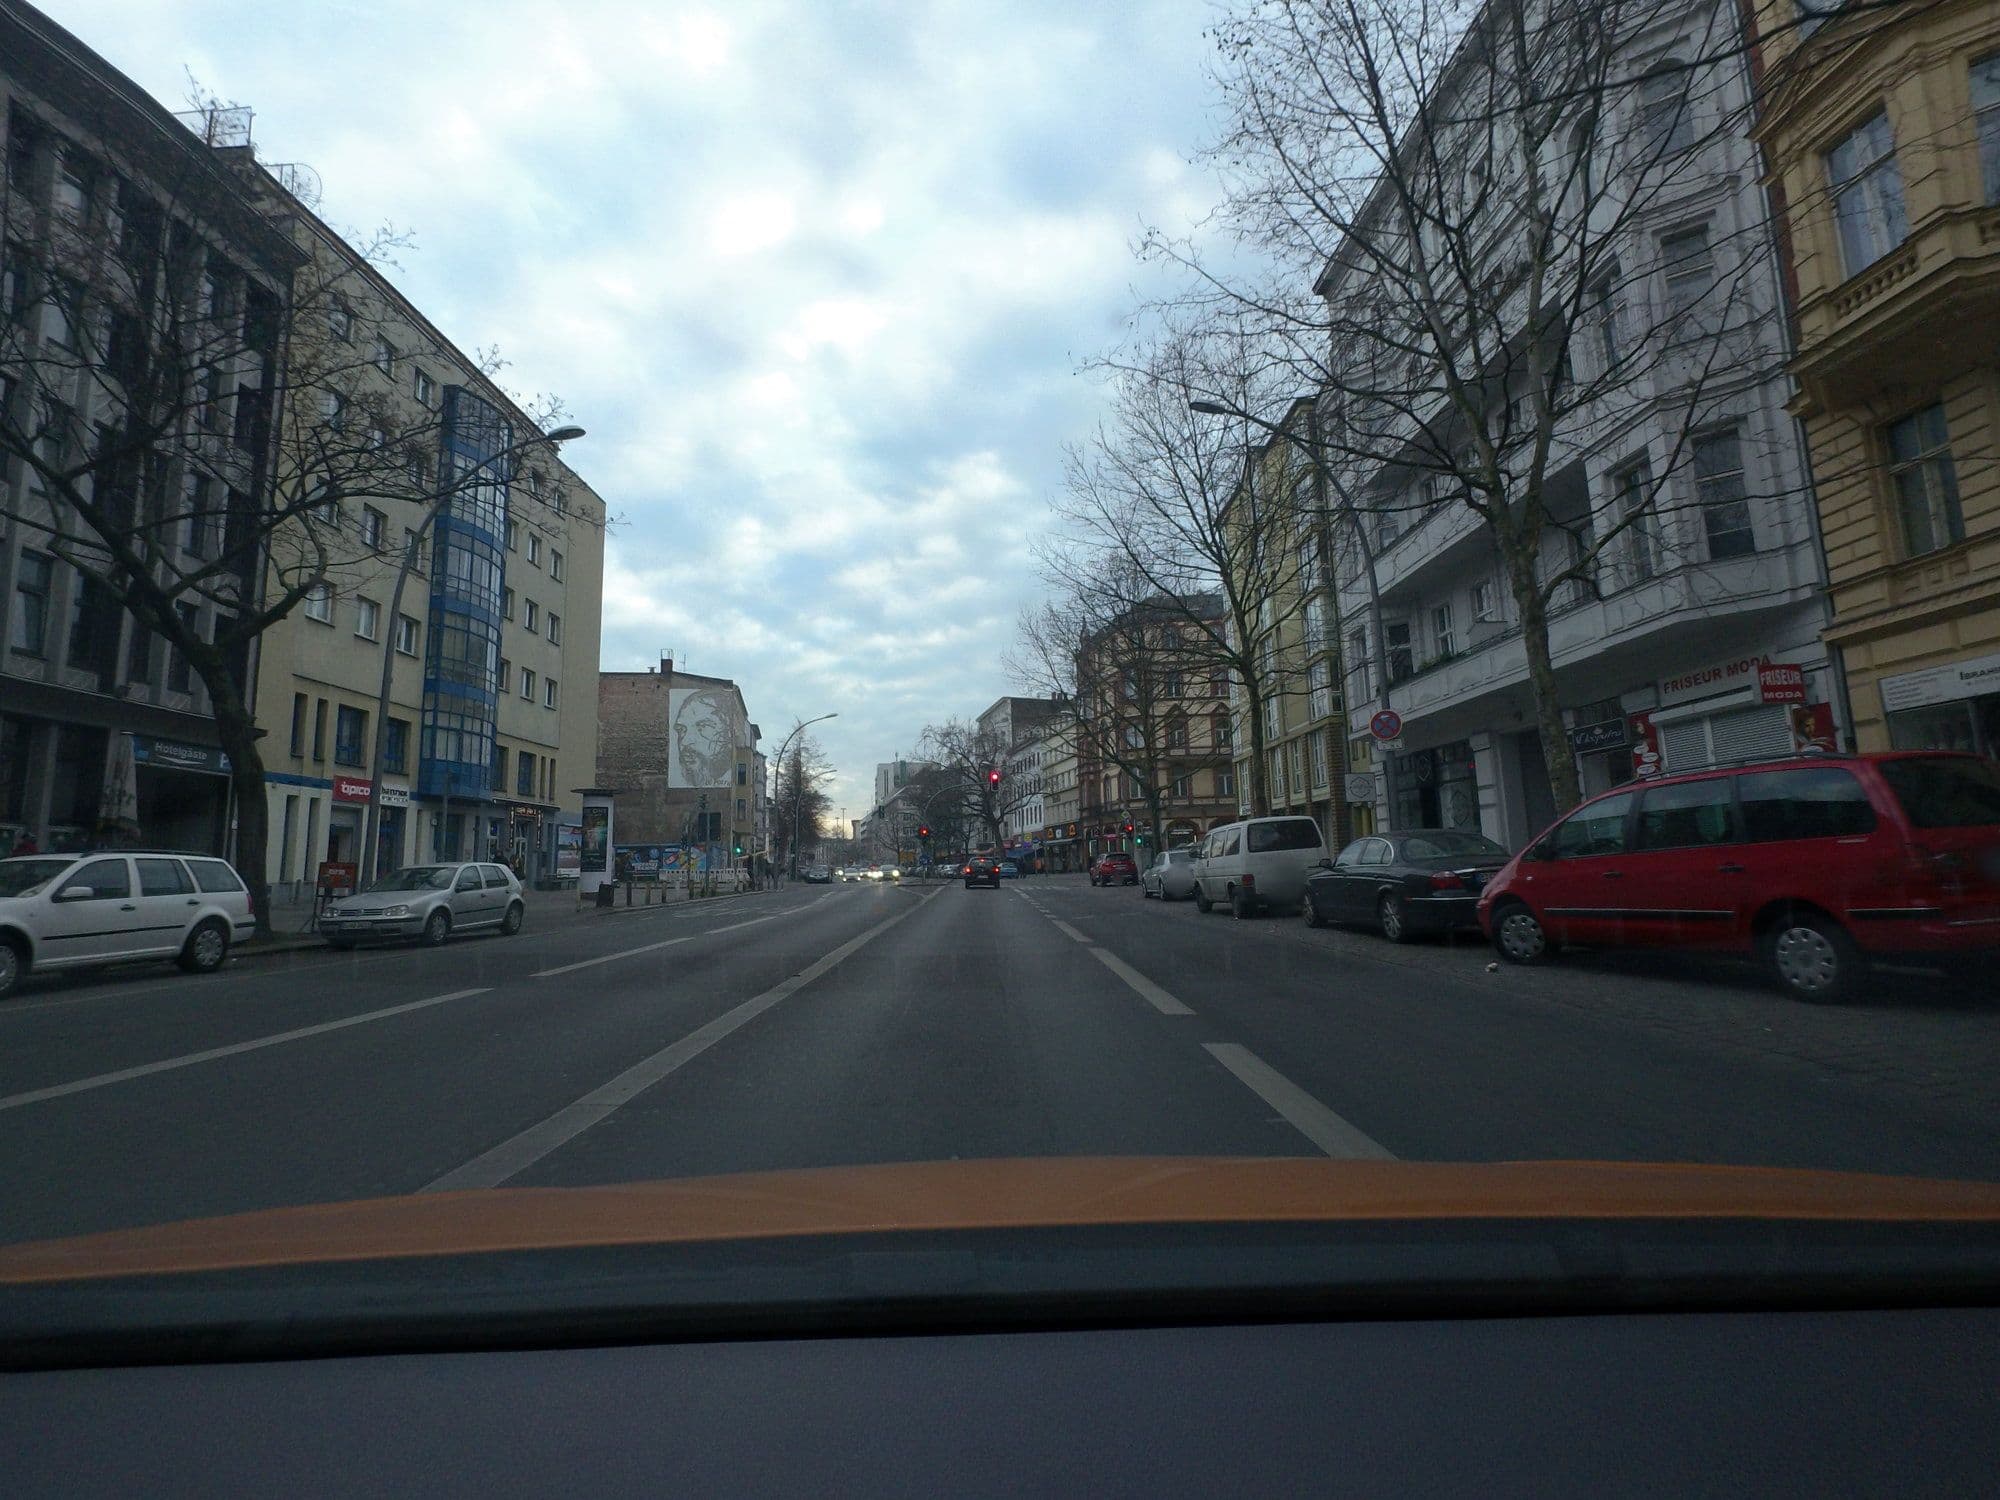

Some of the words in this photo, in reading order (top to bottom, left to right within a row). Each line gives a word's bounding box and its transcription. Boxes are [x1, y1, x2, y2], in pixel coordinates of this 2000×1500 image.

[1664, 667, 1722, 694] FRISEUR
[1727, 653, 1772, 677] MODA
[1760, 669, 1802, 686] FRISEUR
[1763, 691, 1803, 699] MODA
[154, 741, 208, 760] Hotelgäste
[341, 781, 371, 796] tipico
